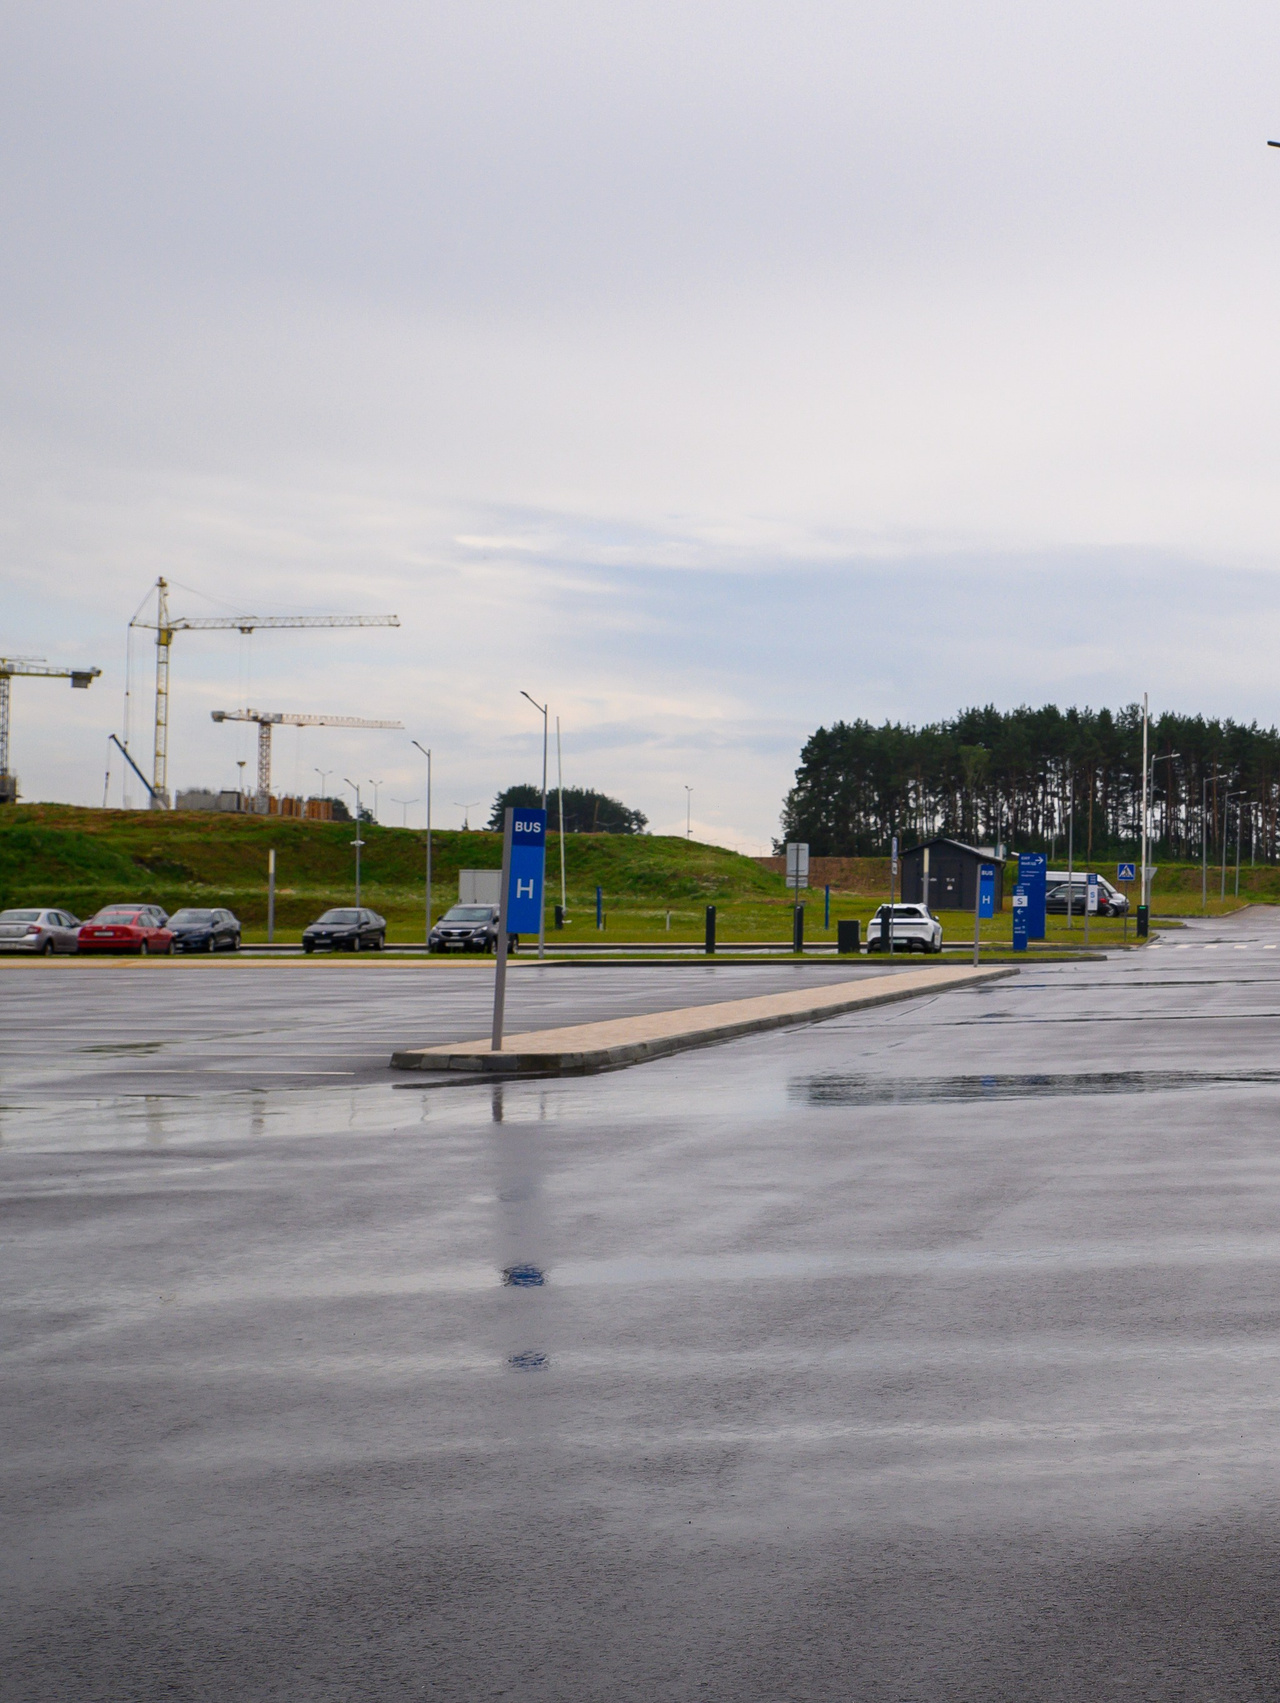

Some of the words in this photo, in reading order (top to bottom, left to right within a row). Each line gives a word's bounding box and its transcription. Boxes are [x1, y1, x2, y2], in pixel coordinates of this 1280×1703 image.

[514, 821, 541, 833] BUS
[516, 878, 534, 899] H
[982, 895, 990, 904] H
[1016, 897, 1023, 905] S
